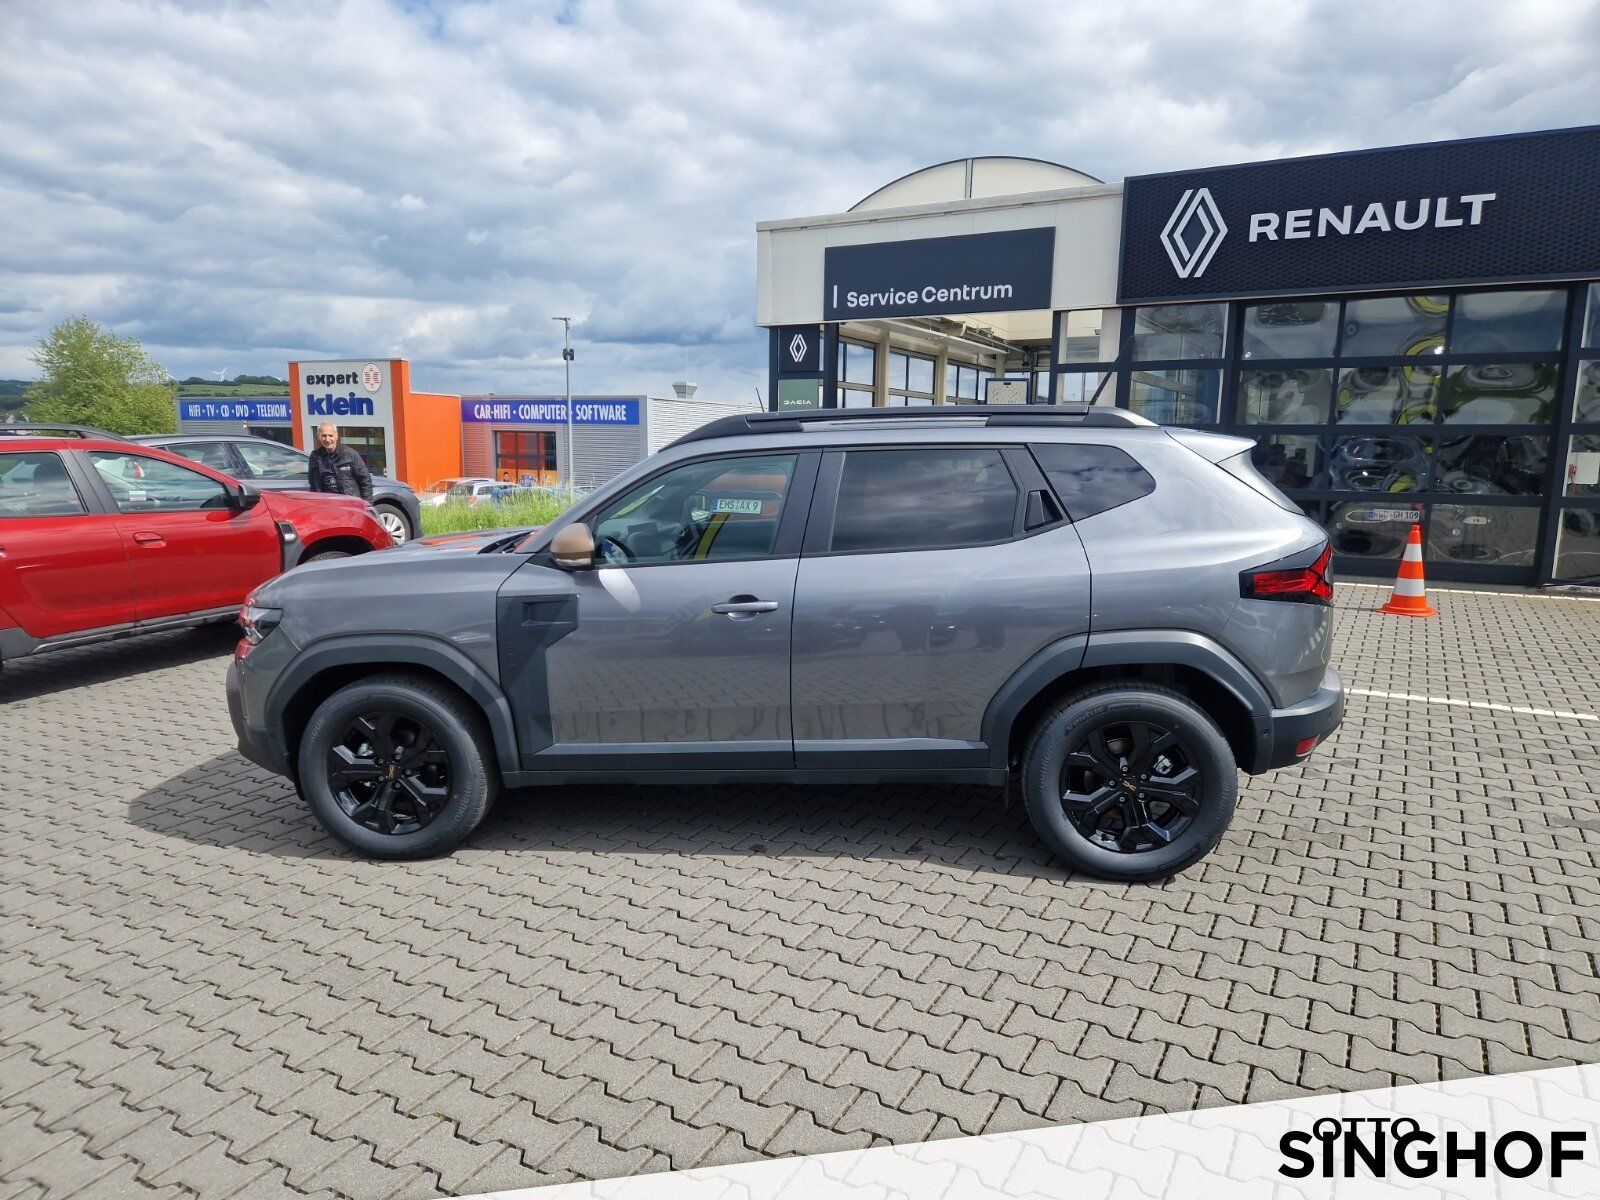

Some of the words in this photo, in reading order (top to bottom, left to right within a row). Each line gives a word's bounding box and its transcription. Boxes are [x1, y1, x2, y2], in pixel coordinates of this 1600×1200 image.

[1248, 192, 1497, 243] RENAULT
[846, 287, 918, 308] Service
[921, 283, 1013, 303] Centrum
[306, 371, 359, 387] expert
[188, 404, 201, 417] HIFI
[205, 404, 215, 417] TV
[220, 404, 230, 418] CD
[235, 404, 249, 418] DVD
[256, 404, 287, 418] TELEKOM
[306, 391, 374, 416] klein
[474, 404, 511, 420] CAR-HIFI
[518, 404, 567, 421] COMPUTER
[575, 404, 627, 421] SOFTWARE
[719, 500, 735, 510] EMS
[740, 501, 751, 511] AX
[753, 502, 759, 511] 9
